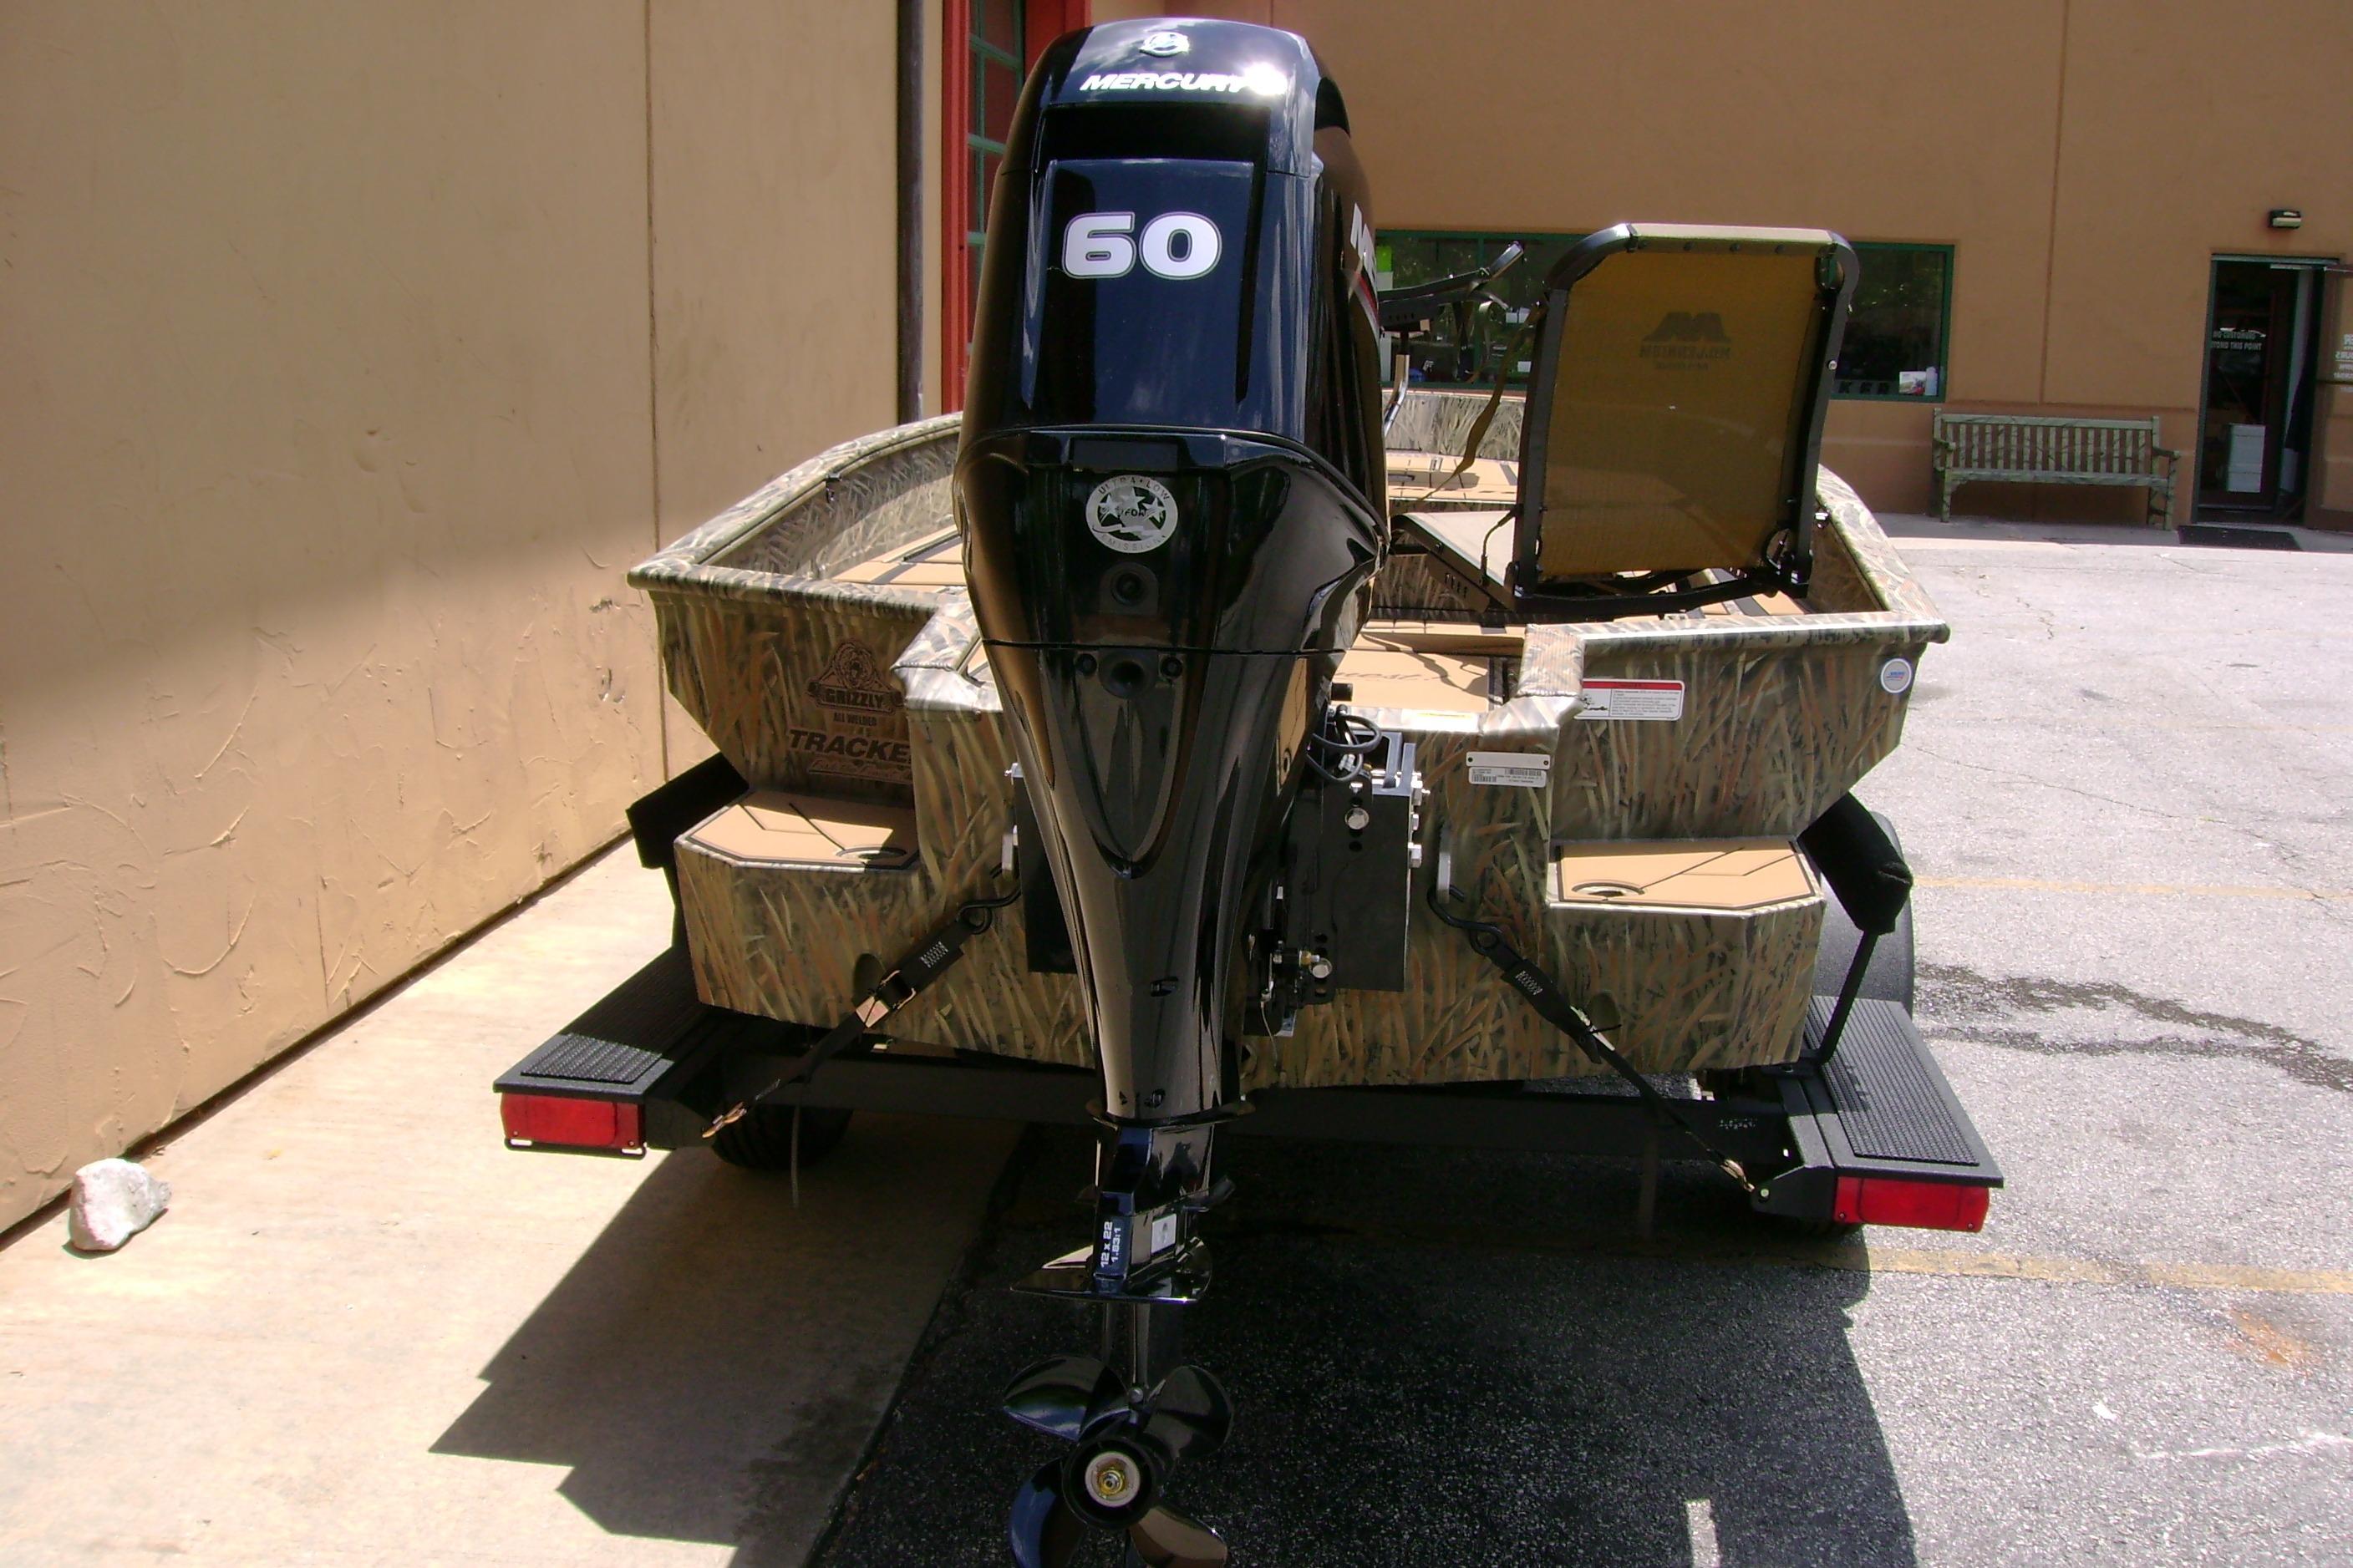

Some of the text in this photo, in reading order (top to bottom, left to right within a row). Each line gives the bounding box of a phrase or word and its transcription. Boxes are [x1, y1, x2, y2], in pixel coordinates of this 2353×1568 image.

[1080, 73, 1254, 92] MERCURY
[1062, 211, 1222, 280] 60
[2244, 342, 2263, 351] POINT
[1146, 480, 1171, 500] LOW
[825, 688, 884, 709] GRIZZLY
[790, 730, 912, 764] TRACKE
